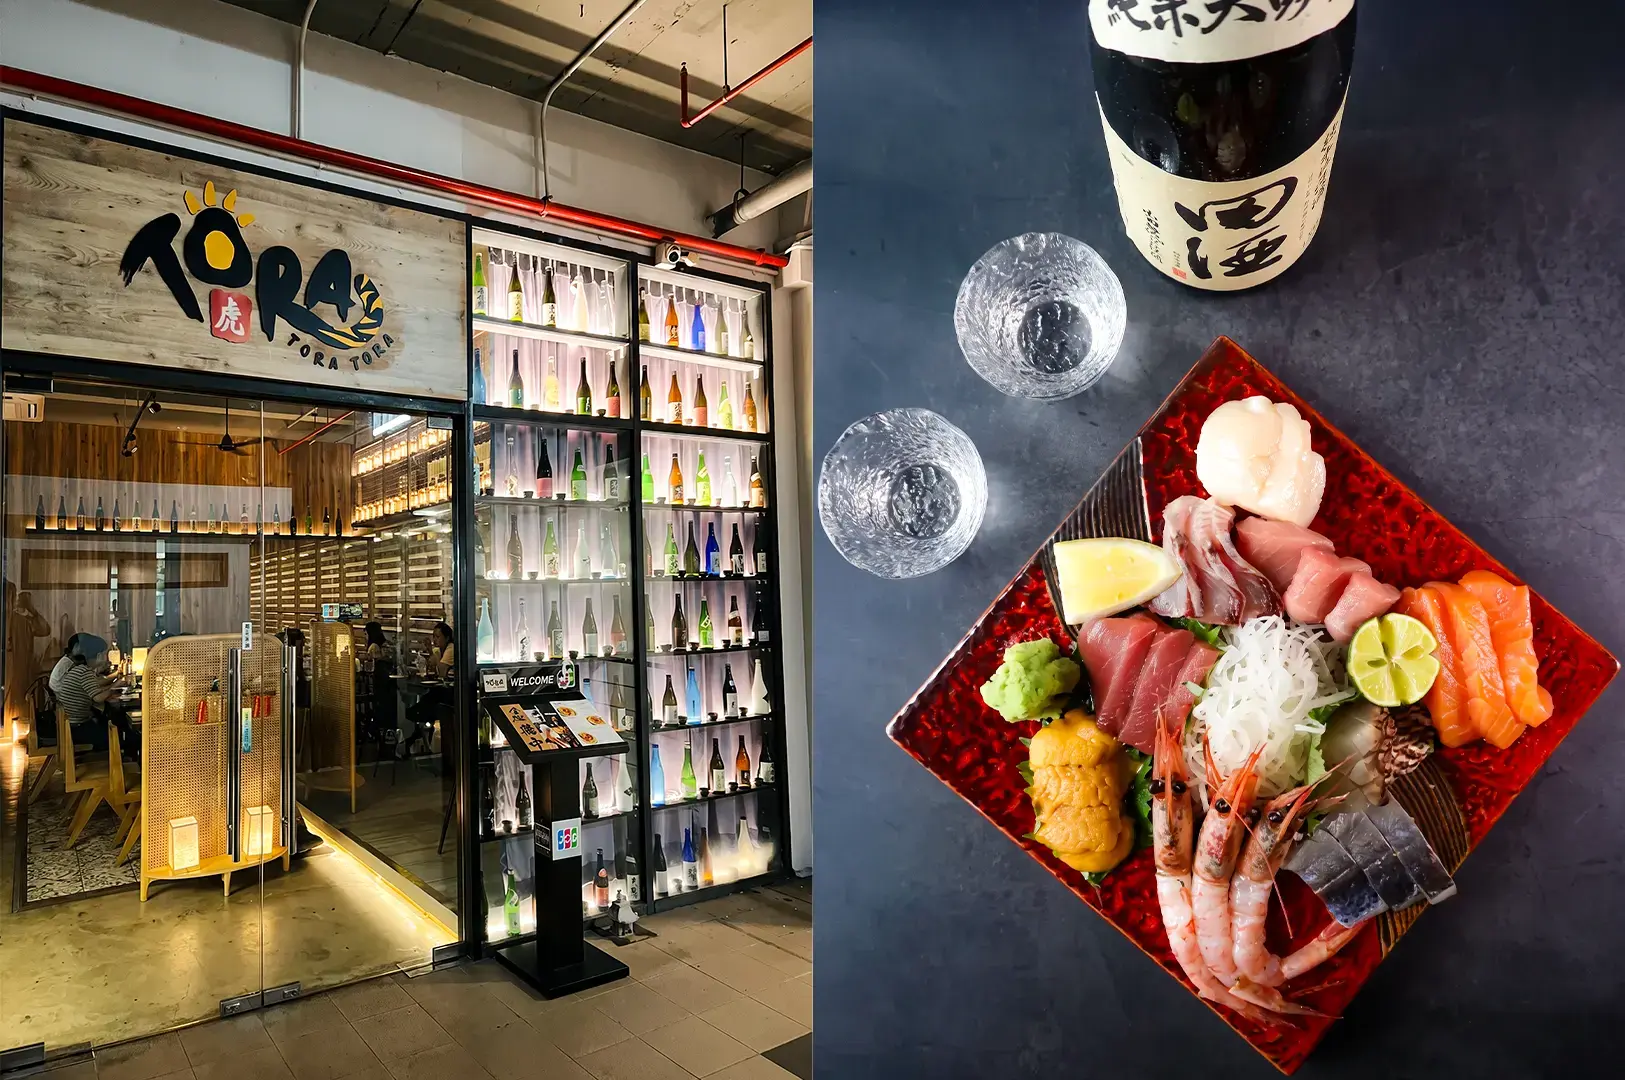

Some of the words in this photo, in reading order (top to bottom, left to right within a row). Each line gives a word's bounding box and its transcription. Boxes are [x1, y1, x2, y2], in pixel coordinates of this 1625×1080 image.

[119, 206, 384, 350] TORA
[214, 296, 246, 336] 虎
[287, 332, 339, 370] TORA
[350, 333, 395, 371] TORA
[510, 675, 555, 687] WELCOME
